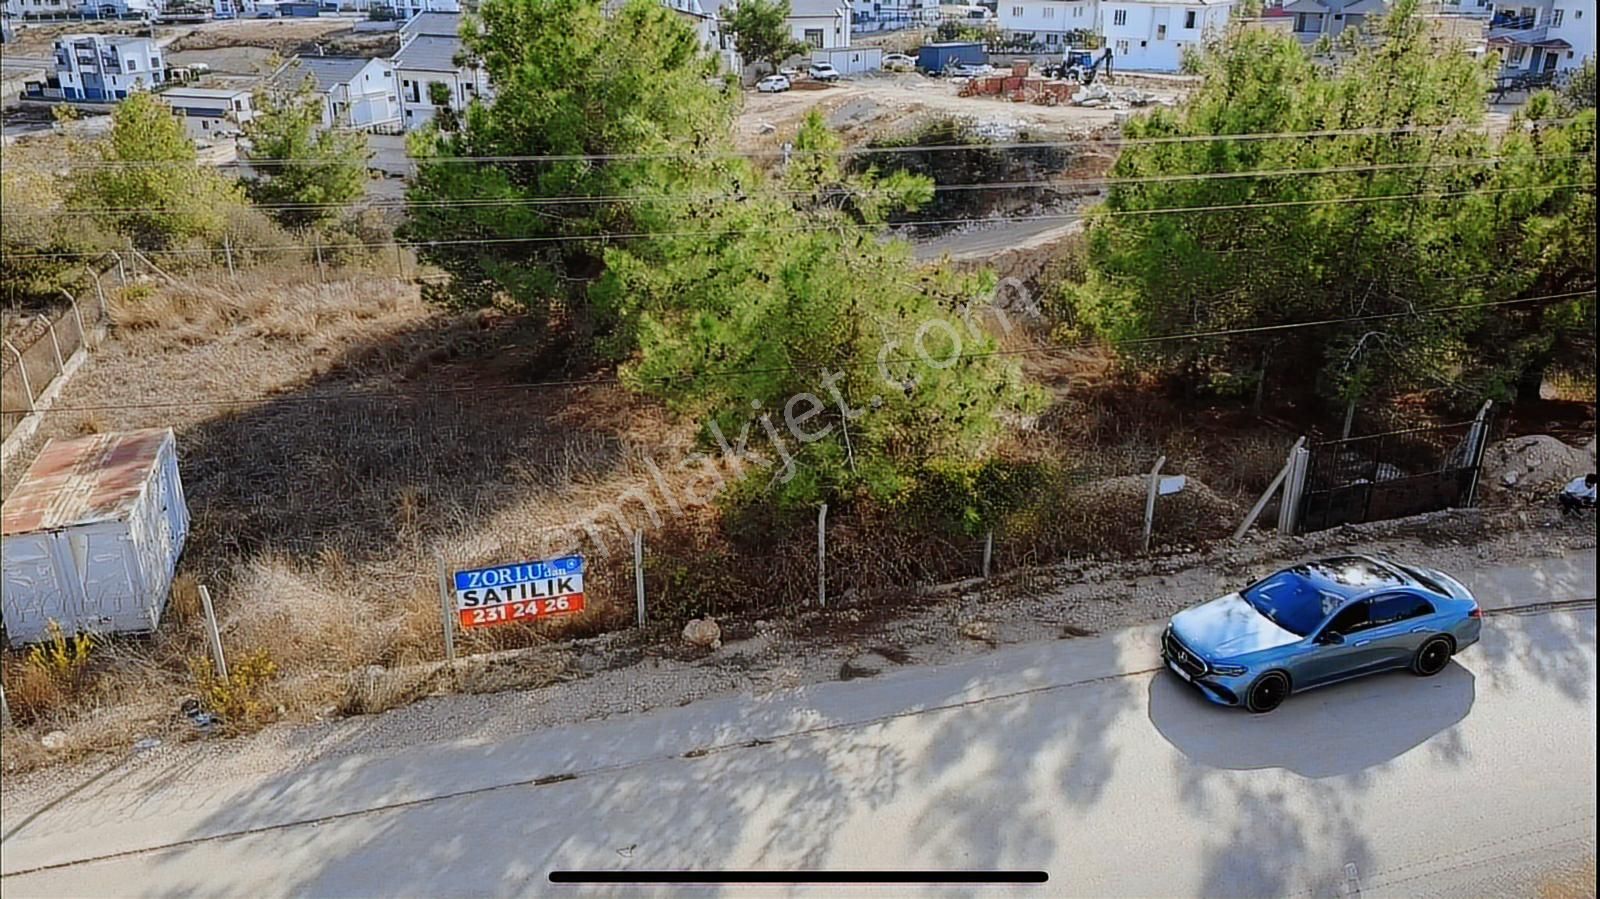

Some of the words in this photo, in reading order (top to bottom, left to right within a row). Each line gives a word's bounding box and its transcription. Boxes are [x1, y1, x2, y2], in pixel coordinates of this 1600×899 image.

[463, 577, 576, 607] SATILIK
[473, 606, 507, 623] 231
[513, 602, 539, 618] 24
[544, 596, 570, 613] 26
